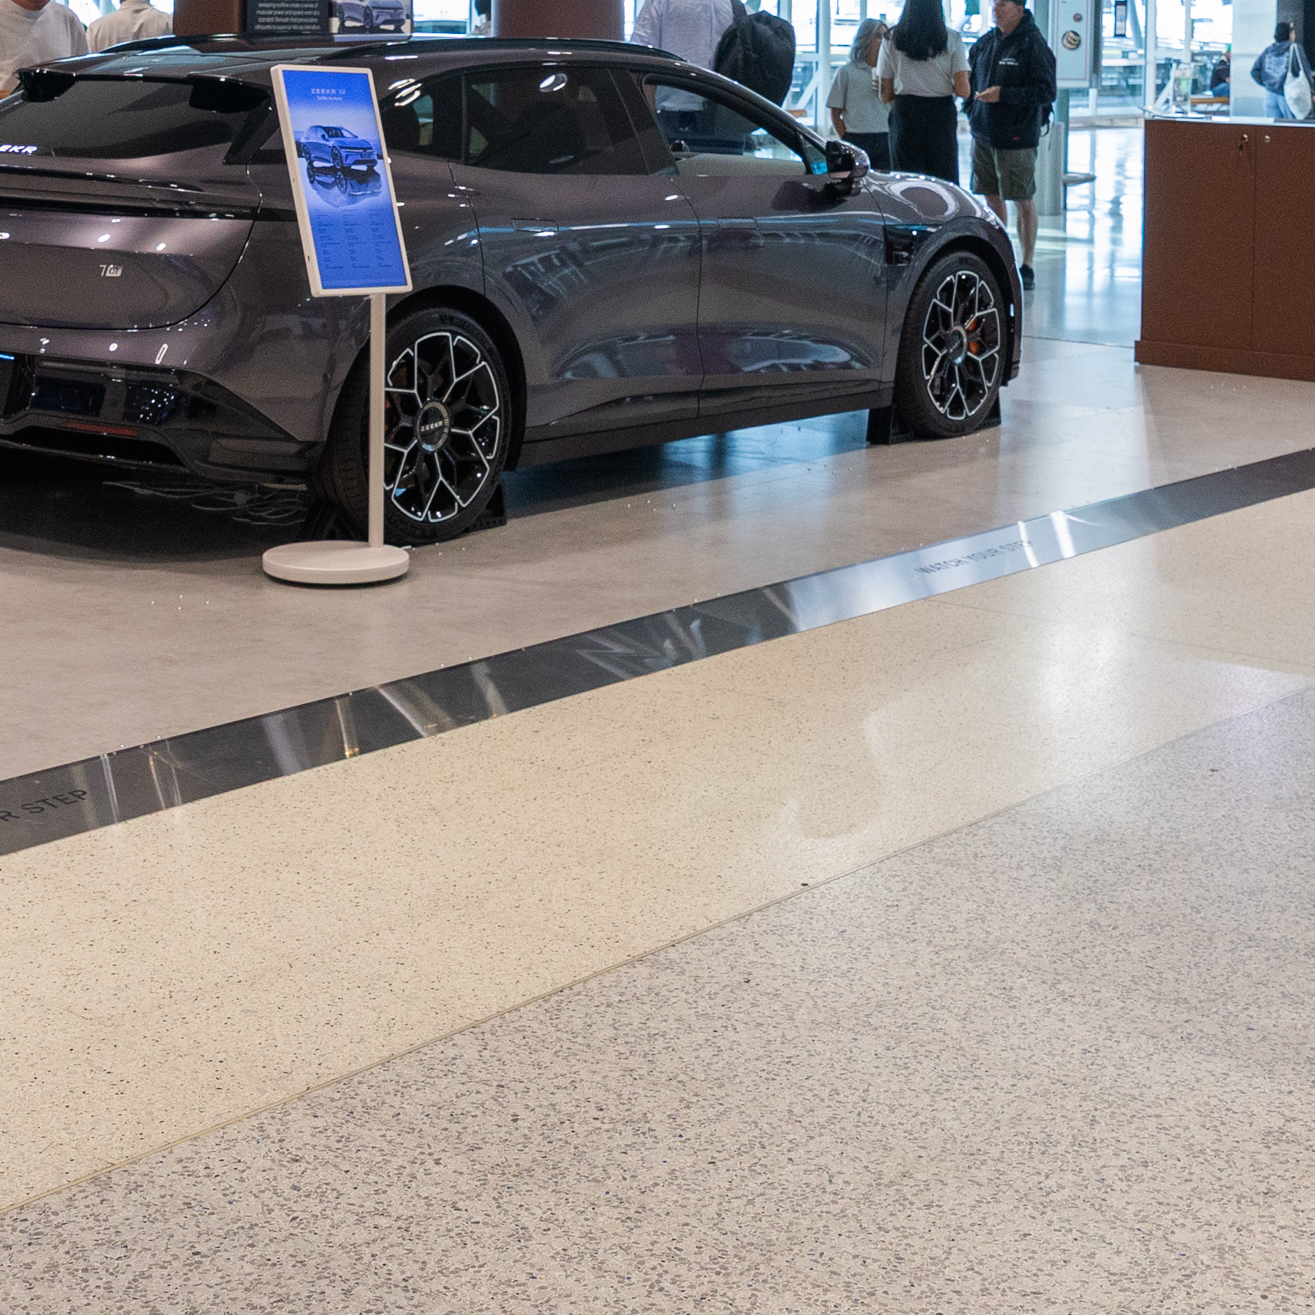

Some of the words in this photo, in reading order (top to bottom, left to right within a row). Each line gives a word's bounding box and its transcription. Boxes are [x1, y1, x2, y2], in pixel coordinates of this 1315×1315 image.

[914, 558, 968, 574] WATCH
[961, 548, 1004, 562] YOUR
[20, 788, 88, 814] STEP
